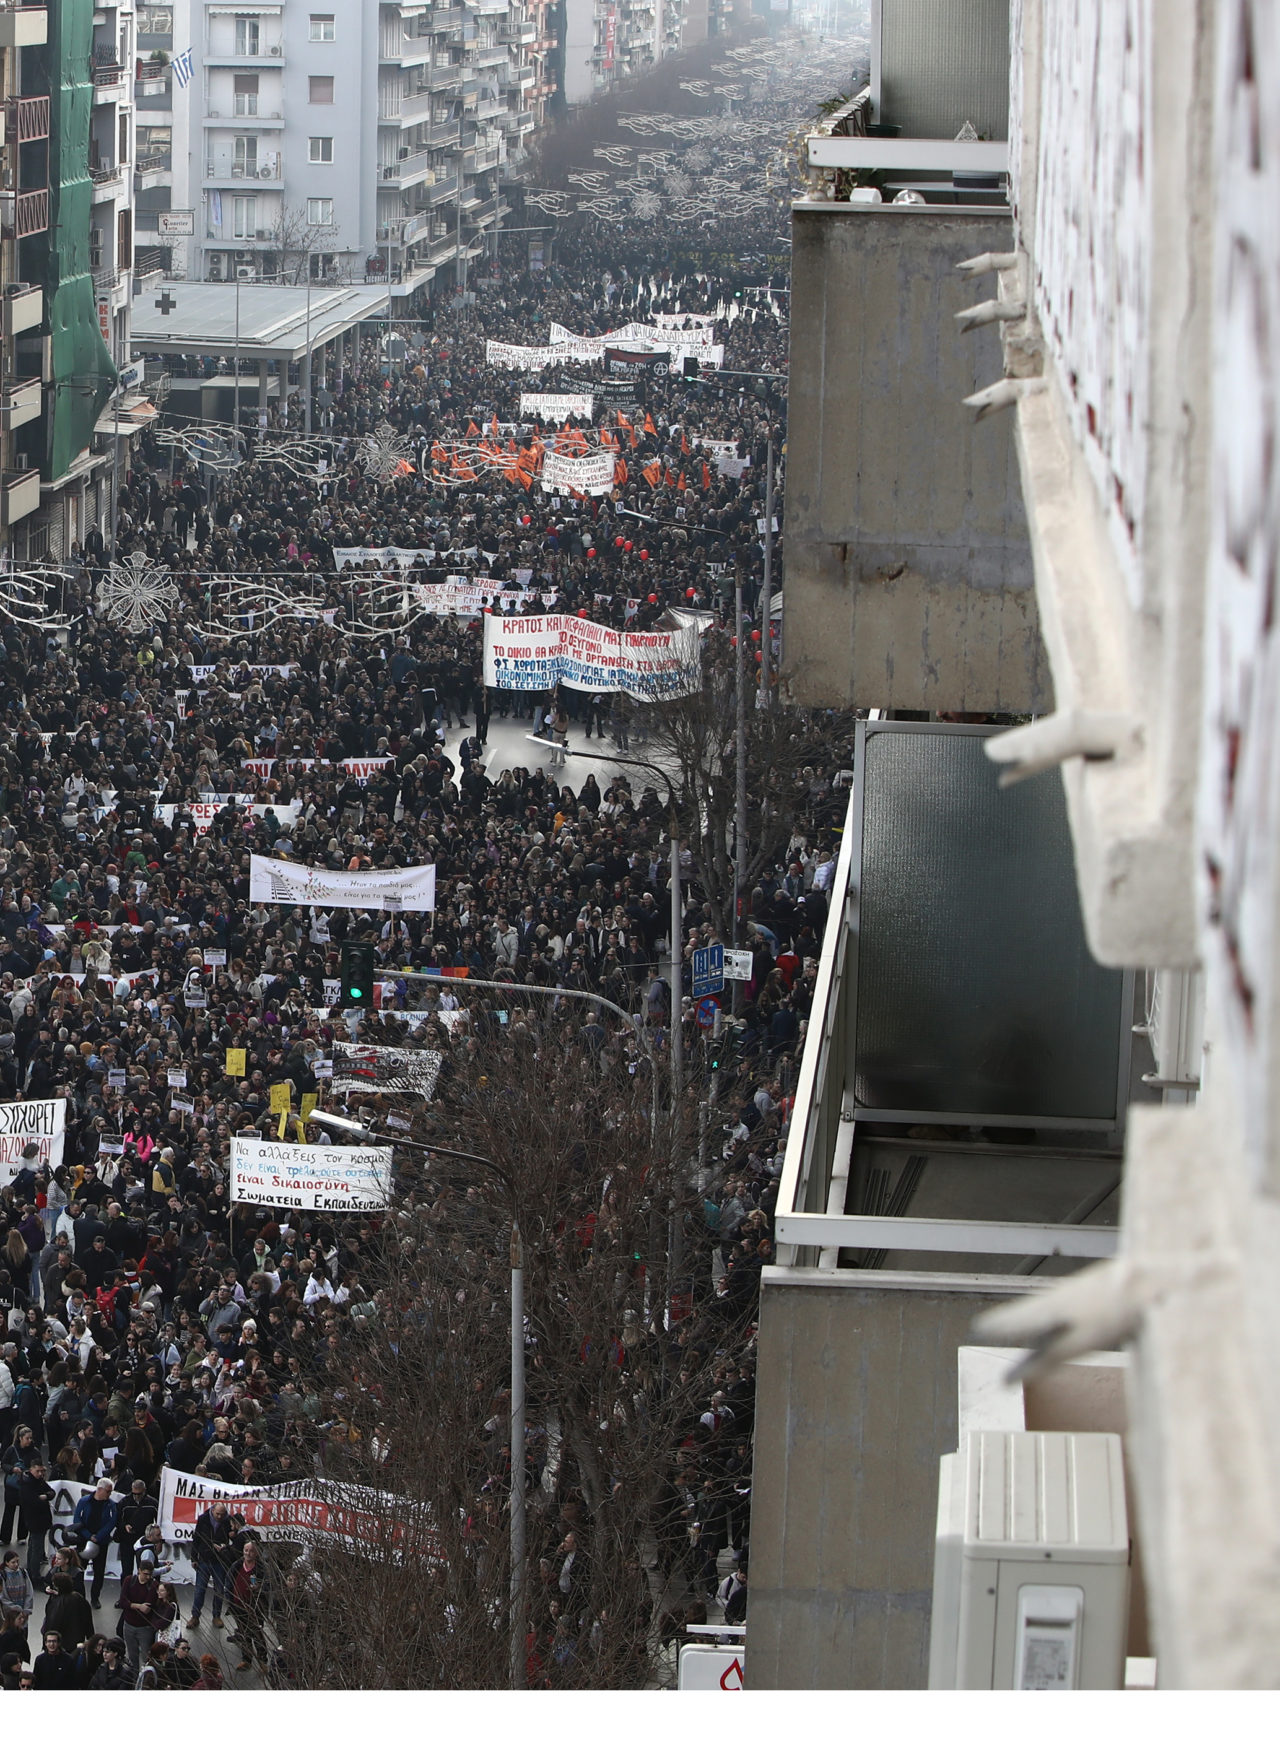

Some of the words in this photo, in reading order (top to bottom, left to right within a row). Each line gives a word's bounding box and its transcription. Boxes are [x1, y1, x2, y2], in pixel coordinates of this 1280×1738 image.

[503, 618, 543, 634] ΚΡΑΤΟΣ
[604, 630, 622, 645] ΜΑΣ
[493, 645, 504, 656] ΤΟ
[0, 1102, 56, 1135] ΣΥΓΧΩΡΕΙ
[236, 1142, 249, 1155] Να
[258, 1146, 315, 1163] αλλάξεις
[324, 1154, 343, 1163] τον
[236, 1158, 252, 1169] δεν
[258, 1161, 280, 1174] είναι
[237, 1172, 264, 1185] είναι
[272, 1175, 350, 1192] δικαιοσύνη
[237, 1188, 302, 1206] Σωματεία
[176, 1477, 207, 1499] ΜΑΣ
